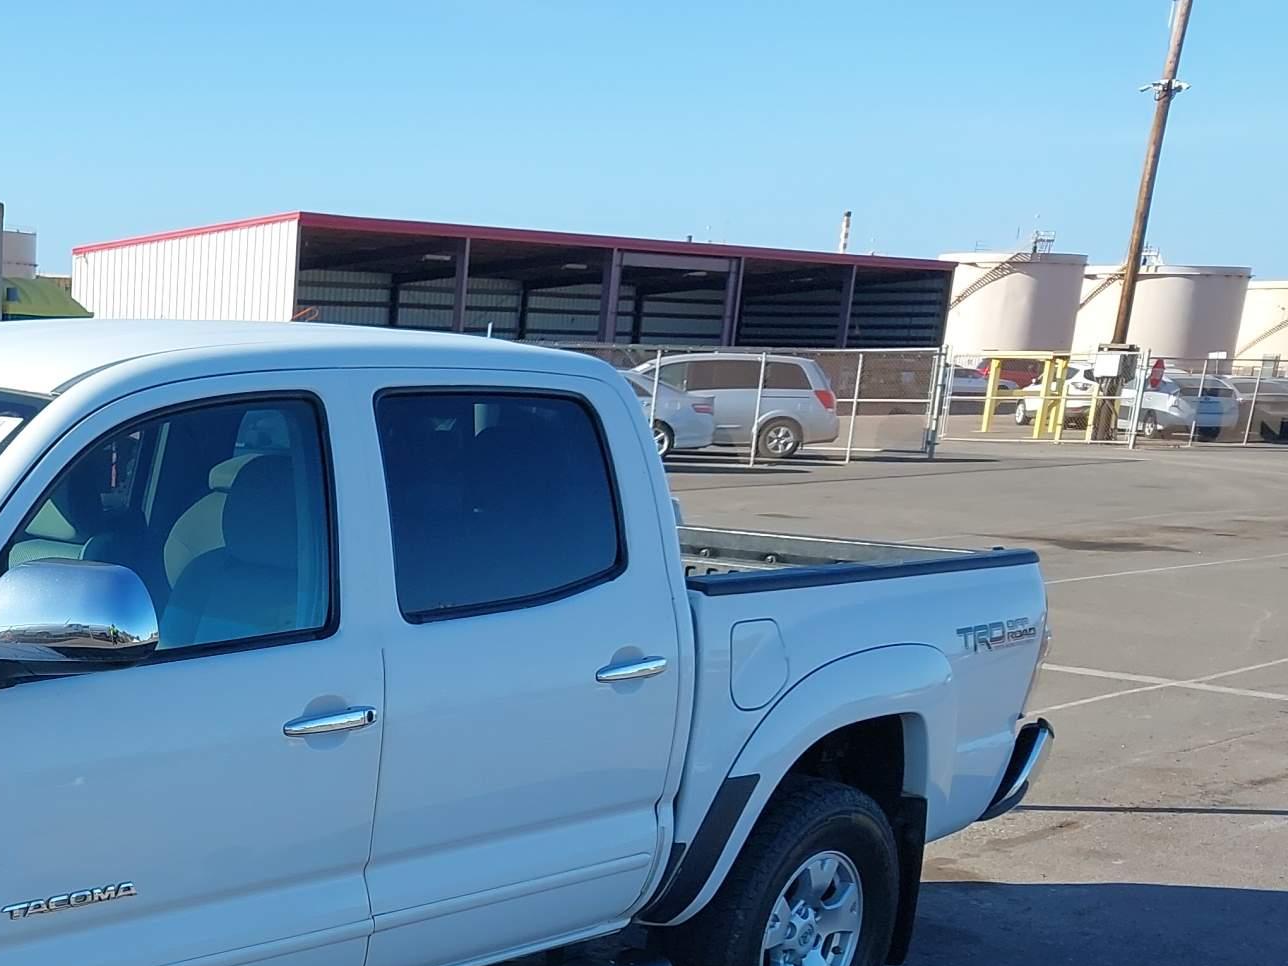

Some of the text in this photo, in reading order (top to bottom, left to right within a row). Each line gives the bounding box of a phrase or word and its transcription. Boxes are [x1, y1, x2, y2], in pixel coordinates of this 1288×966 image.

[956, 621, 1005, 651] TRD
[1007, 627, 1037, 640] ROAD
[0, 880, 137, 920] TACOMA
